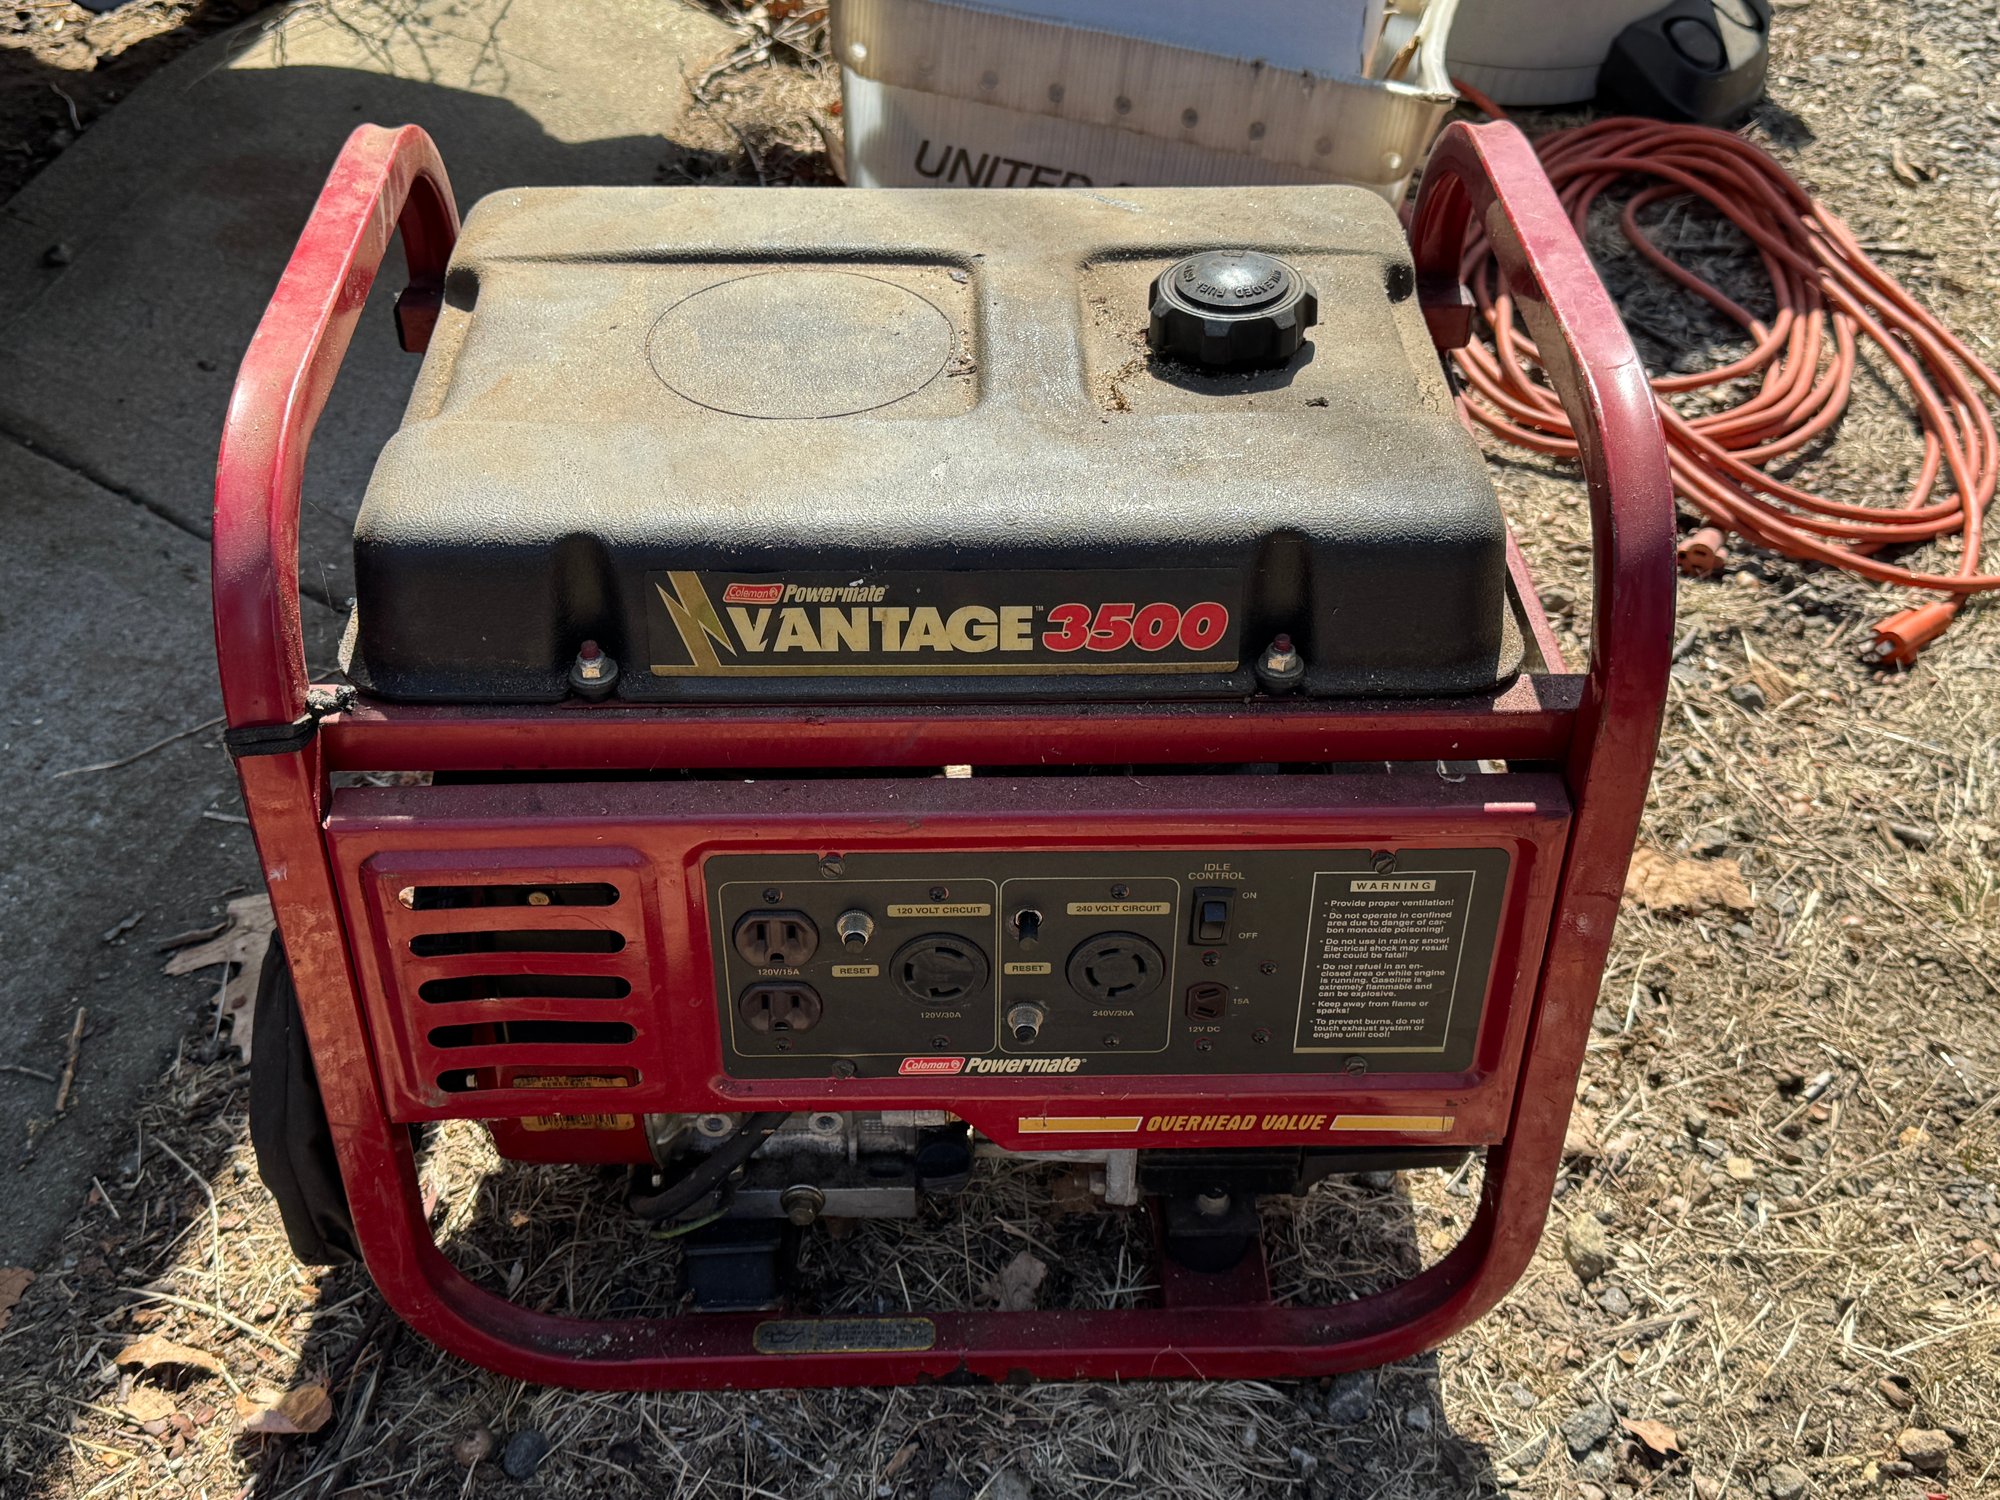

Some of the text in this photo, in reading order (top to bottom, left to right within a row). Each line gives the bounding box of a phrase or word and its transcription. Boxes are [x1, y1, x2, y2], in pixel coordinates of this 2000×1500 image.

[1197, 282, 1227, 298] FUEL
[729, 586, 769, 598] Coleman
[1042, 601, 1229, 652] 3500
[1204, 863, 1231, 871] IDLE
[1188, 872, 1245, 880] CONTROL
[1356, 882, 1431, 890] WARNING
[942, 906, 982, 914] CIRCUIT
[1394, 926, 1444, 934] poisoning!
[1238, 932, 1258, 940] OFF
[840, 967, 872, 975] RESET
[1319, 983, 1363, 991] extremely
[1350, 990, 1397, 998] explosive.
[1316, 1007, 1350, 1015] sparks!
[905, 1060, 949, 1070] Coleman
[1146, 1115, 1257, 1131] OVERHEAD
